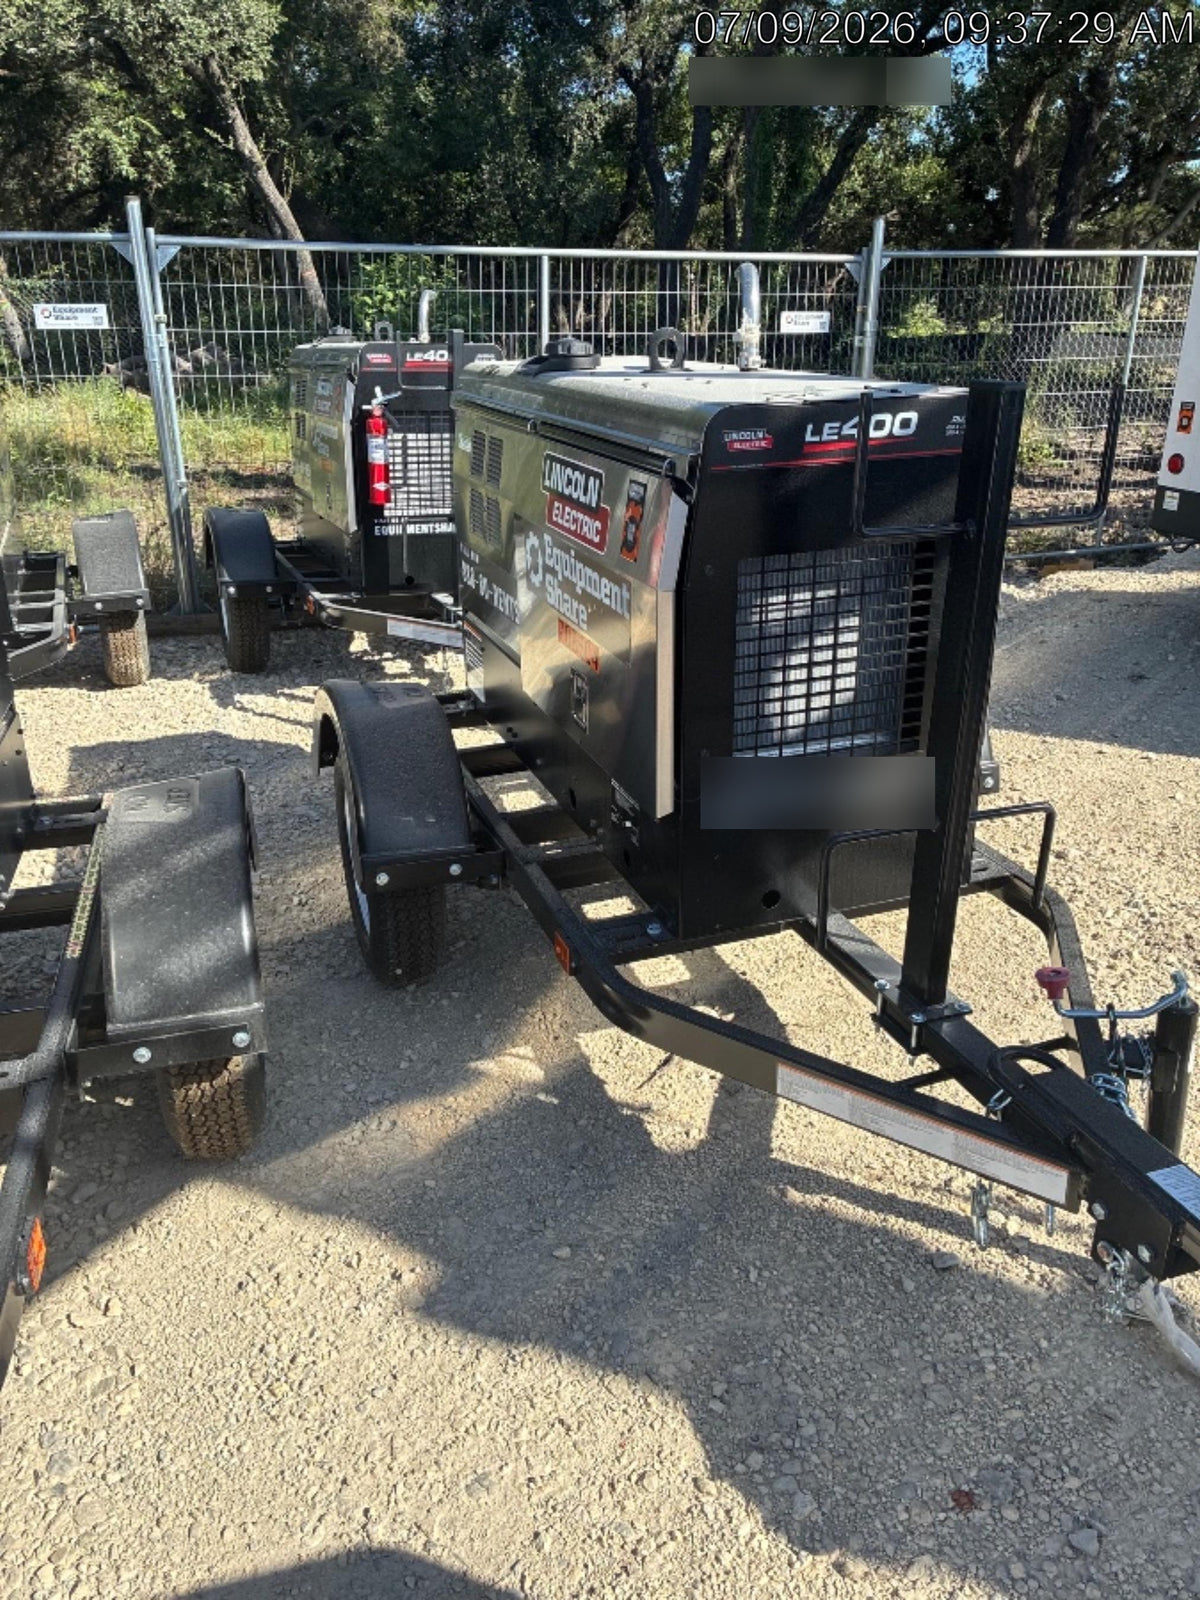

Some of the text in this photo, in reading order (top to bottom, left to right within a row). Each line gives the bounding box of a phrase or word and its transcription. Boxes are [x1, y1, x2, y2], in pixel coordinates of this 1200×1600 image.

[406, 350, 449, 362] LE40
[724, 431, 764, 442] LINCOLN
[544, 458, 600, 508] LINCOLN
[552, 500, 602, 543] ELECTRIC
[543, 532, 630, 621] Equipment
[545, 571, 588, 632] Share
